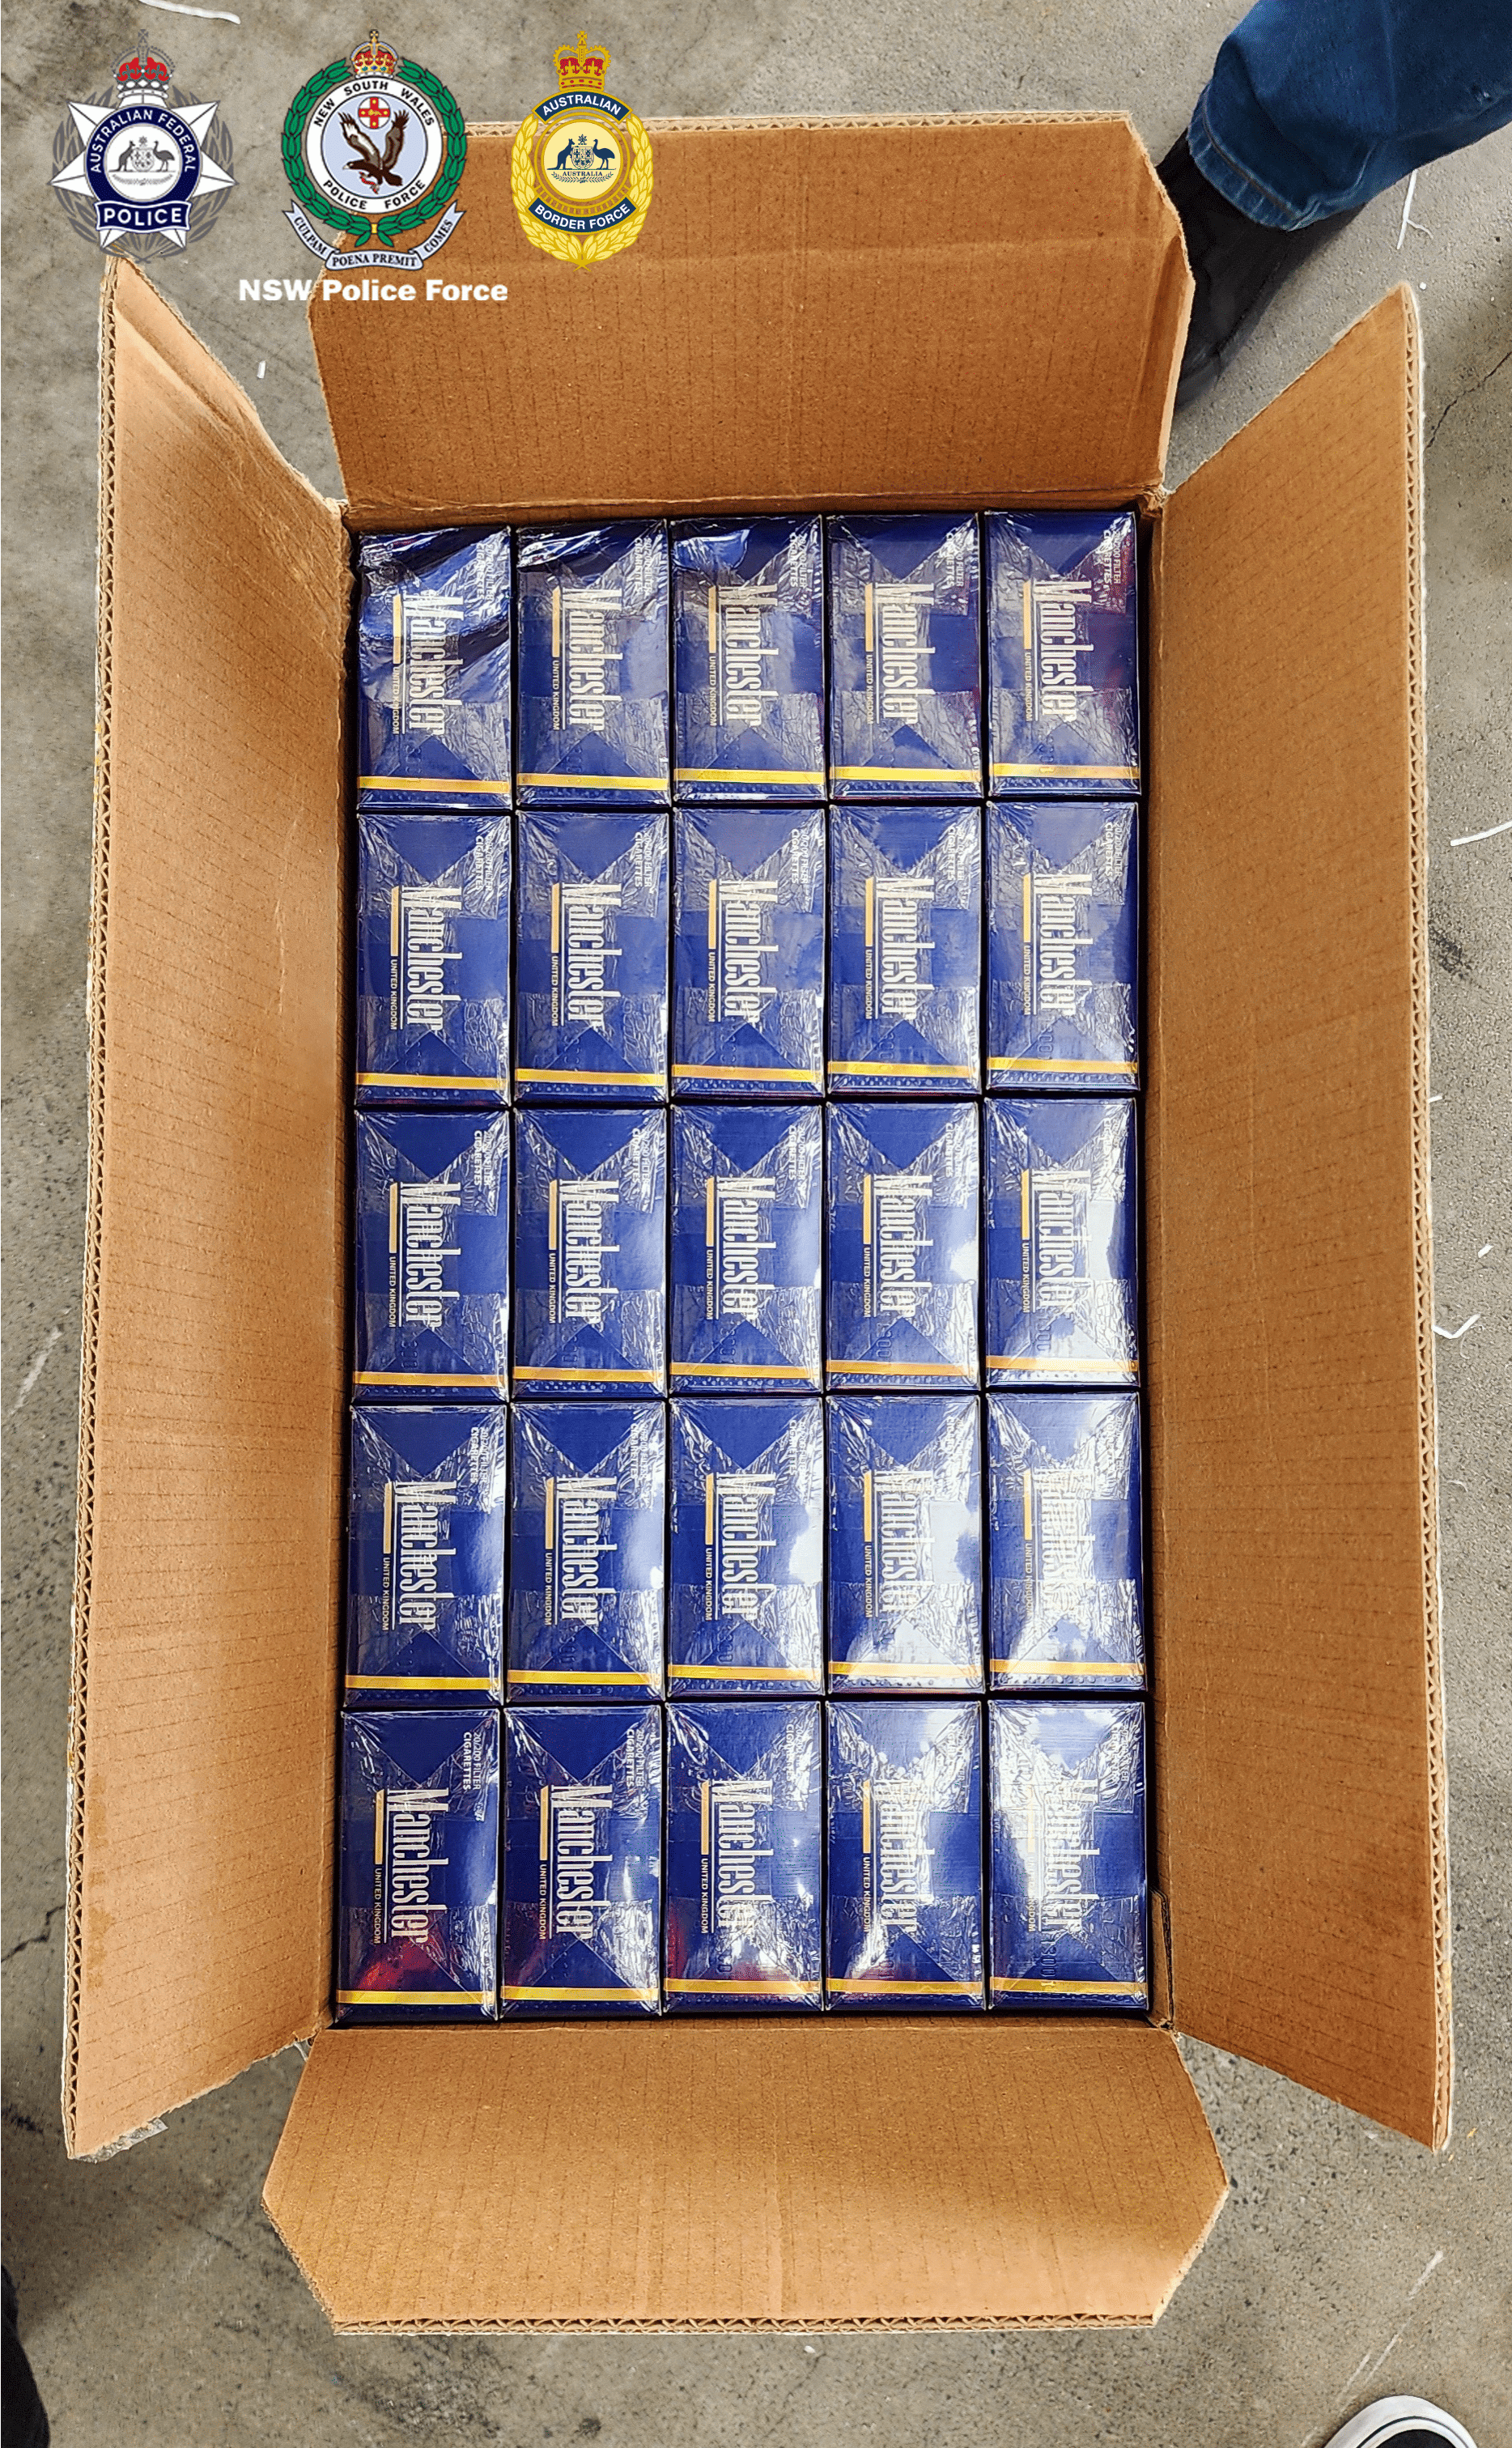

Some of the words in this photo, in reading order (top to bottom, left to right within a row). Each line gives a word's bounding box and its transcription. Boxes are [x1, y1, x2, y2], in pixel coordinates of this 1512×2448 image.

[402, 594, 463, 735] Manchester
[563, 588, 622, 731] Manchester
[719, 584, 779, 726] Manchester
[876, 582, 936, 725] Manchester
[1034, 580, 1094, 721] Manchester
[401, 886, 462, 1031] Manchester
[562, 882, 622, 1026] Manchester
[720, 879, 778, 1022] Manchester
[877, 878, 935, 1020] Manchester
[1034, 873, 1093, 1017] Manchester
[400, 1183, 461, 1328] Manchester
[560, 1179, 619, 1324] Manchester
[717, 1176, 776, 1320] Manchester
[874, 1174, 933, 1317] Manchester
[1032, 1170, 1091, 1313] Manchester
[394, 1481, 456, 1630] Manchester
[557, 1477, 618, 1626] Manchester
[716, 1473, 776, 1621] Manchester
[874, 1470, 935, 1615] Manchester
[1034, 1468, 1095, 1617] anchest
[463, 1732, 471, 1790] CIGARETTES
[473, 1732, 481, 1761] 20/200
[473, 1763, 481, 1790] FILTER
[626, 1729, 635, 1787] CIGARETTES
[636, 1729, 644, 1757] 20/200
[636, 1760, 644, 1787] FILTER
[388, 1788, 448, 1943] Manchester
[551, 1785, 613, 1940] Manchester
[711, 1780, 773, 1932] Manchester
[875, 1779, 935, 1932] Manchester
[1028, 1890, 1036, 1932] NGDOM
[1043, 1779, 1100, 1934] Manchester
